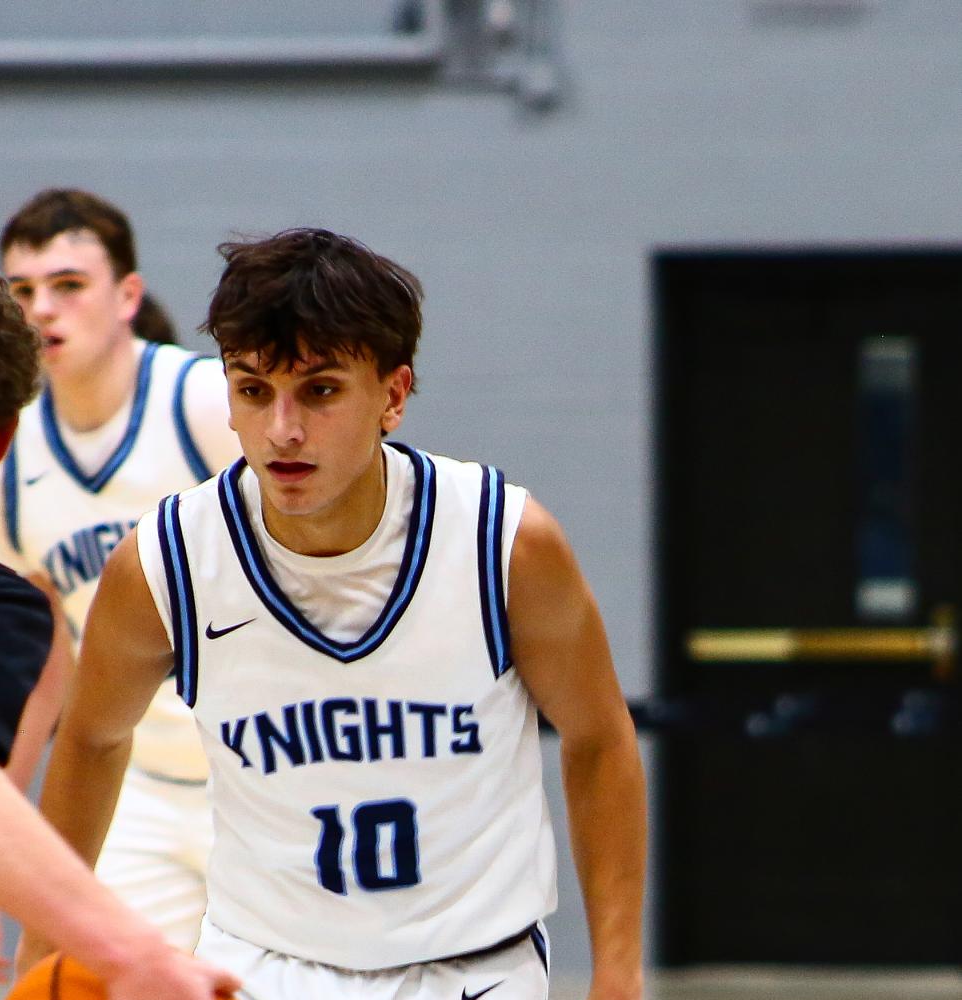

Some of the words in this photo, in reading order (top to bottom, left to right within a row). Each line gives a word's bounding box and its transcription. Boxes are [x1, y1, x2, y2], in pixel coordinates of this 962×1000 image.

[43, 518, 137, 595] KNIG
[219, 696, 484, 776] KNIGHTS
[309, 796, 422, 897] 10
